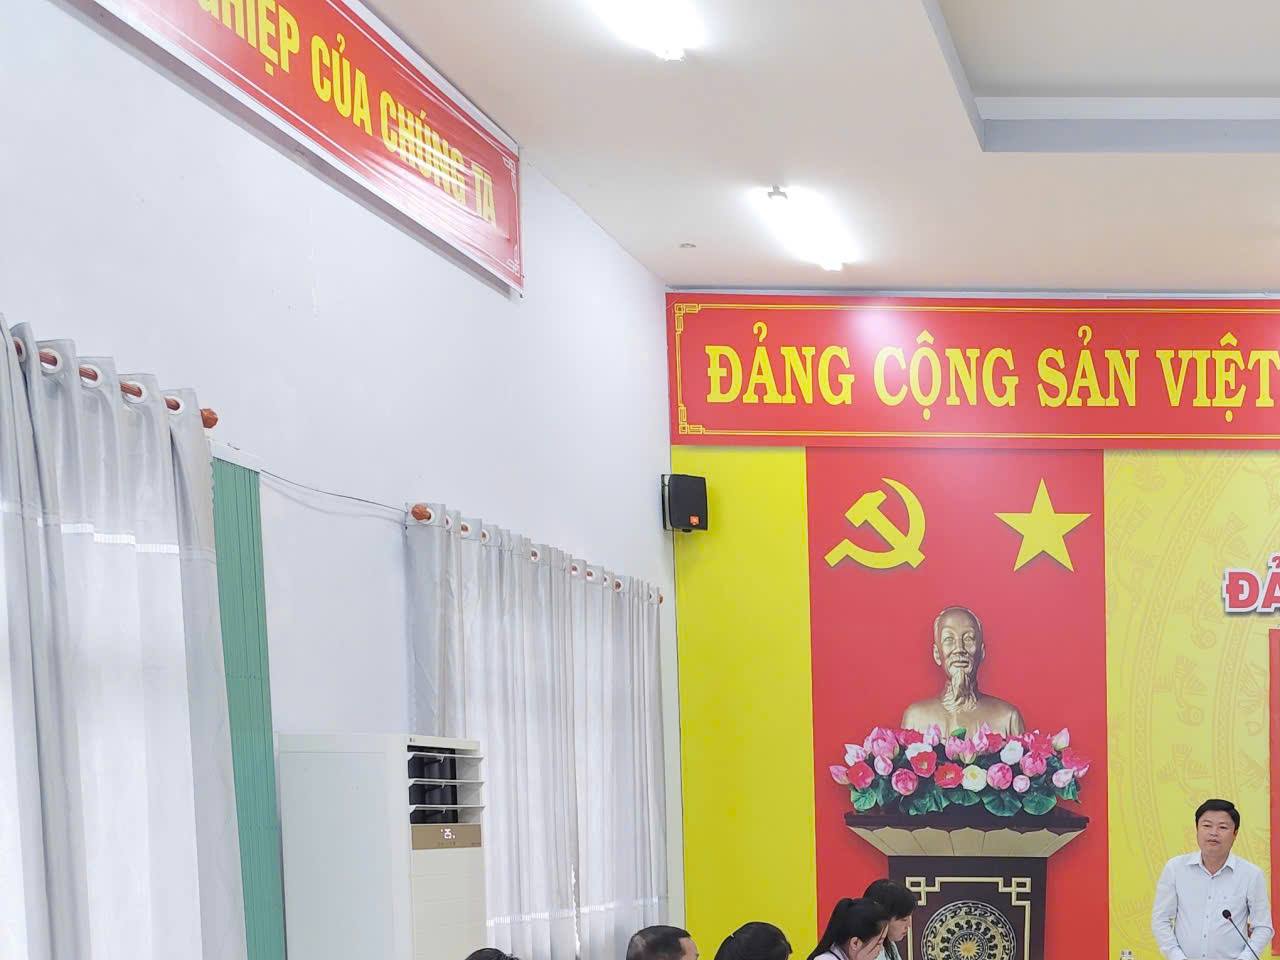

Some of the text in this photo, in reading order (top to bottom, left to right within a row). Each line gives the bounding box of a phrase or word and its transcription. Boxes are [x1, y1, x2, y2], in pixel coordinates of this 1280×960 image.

[311, 33, 373, 136] CỦA
[380, 90, 466, 207] CHÚNG
[471, 161, 497, 229] TA
[705, 322, 855, 405] ĐẢNG
[873, 331, 1019, 421] CỘNG
[1037, 325, 1139, 408] SẢN
